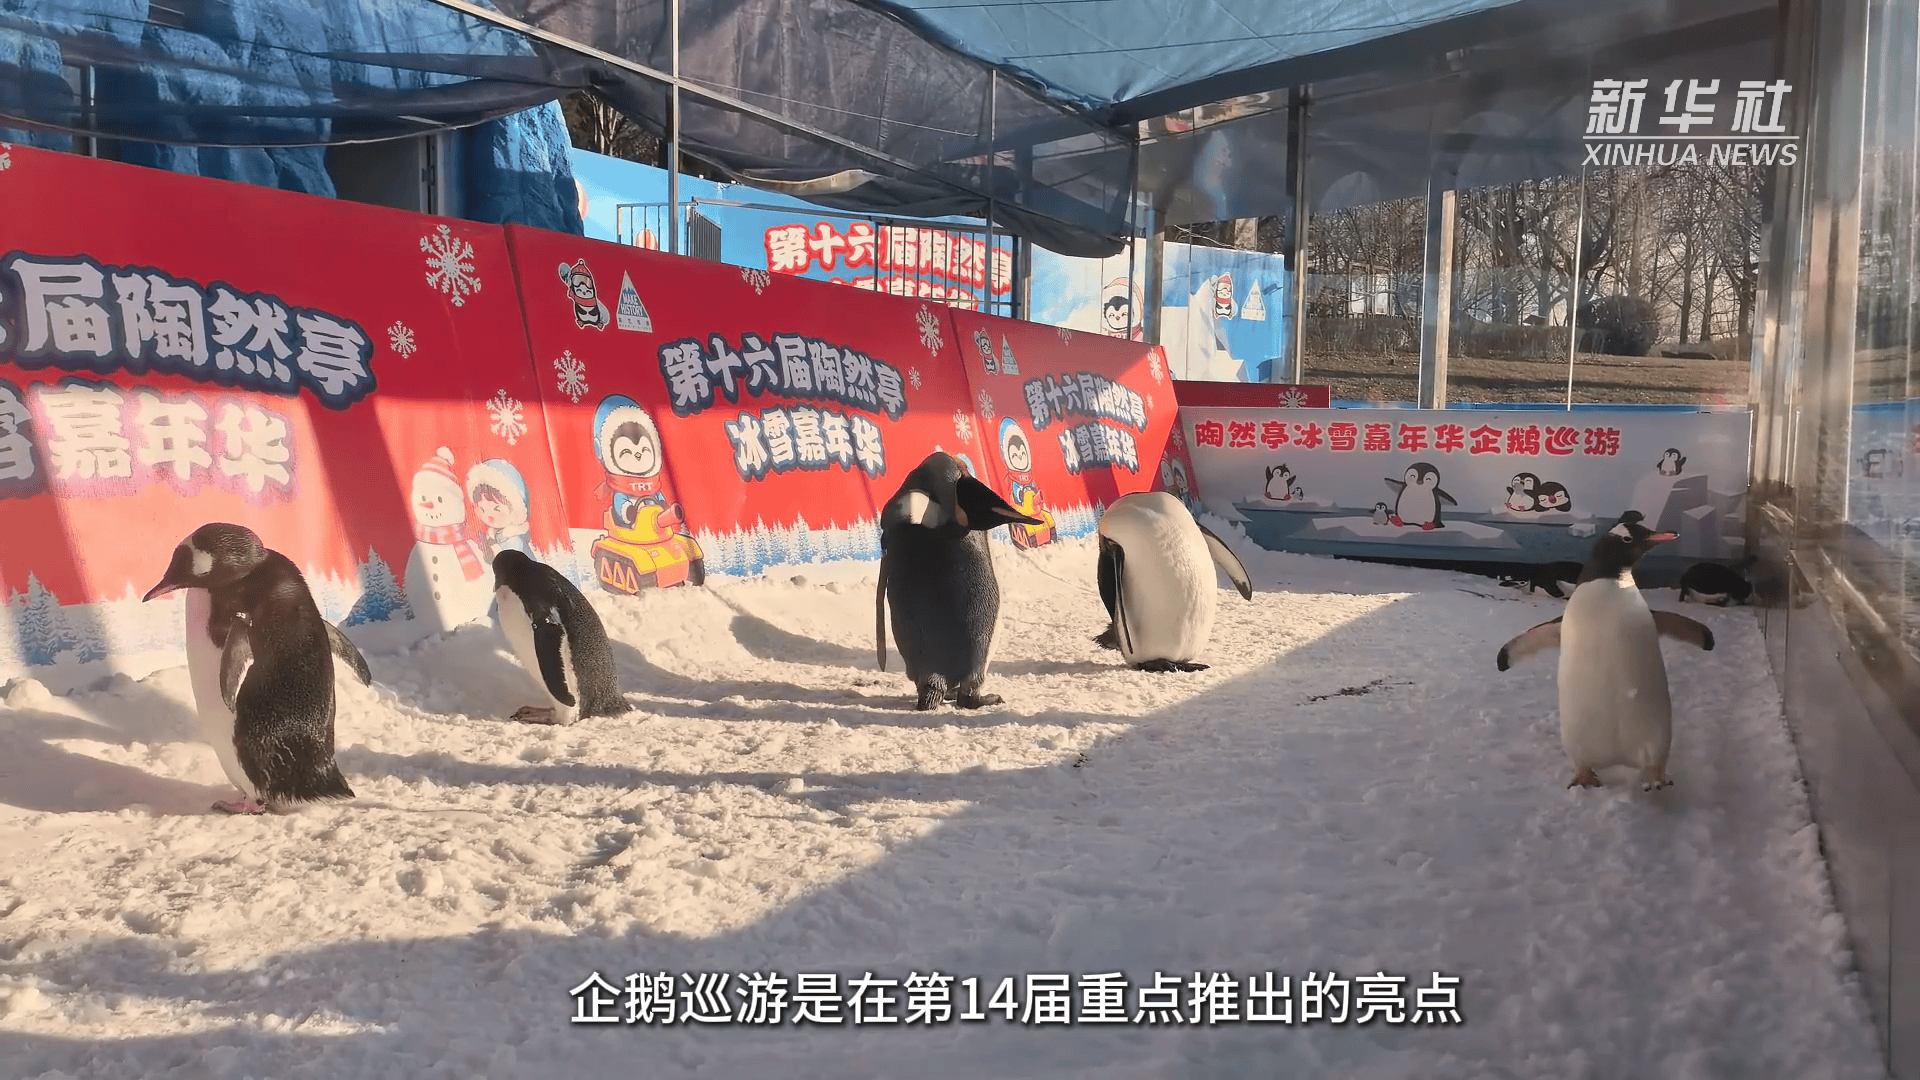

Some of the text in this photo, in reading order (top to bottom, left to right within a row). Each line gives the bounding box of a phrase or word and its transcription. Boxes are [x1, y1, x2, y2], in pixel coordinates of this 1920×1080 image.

[768, 223, 1012, 289] 第十六届陶然亭
[0, 258, 369, 396] 届陶然亭
[662, 336, 905, 413] 第十六届陶然亭
[1024, 374, 1147, 428] 第十六届陶然亭
[727, 407, 884, 472] 冰雪嘉年华
[1058, 424, 1139, 474] 冰雪嘉年华
[1194, 421, 1621, 456] 陶然亭冰雪嘉年华企鹅巡游
[629, 482, 654, 492] TRT
